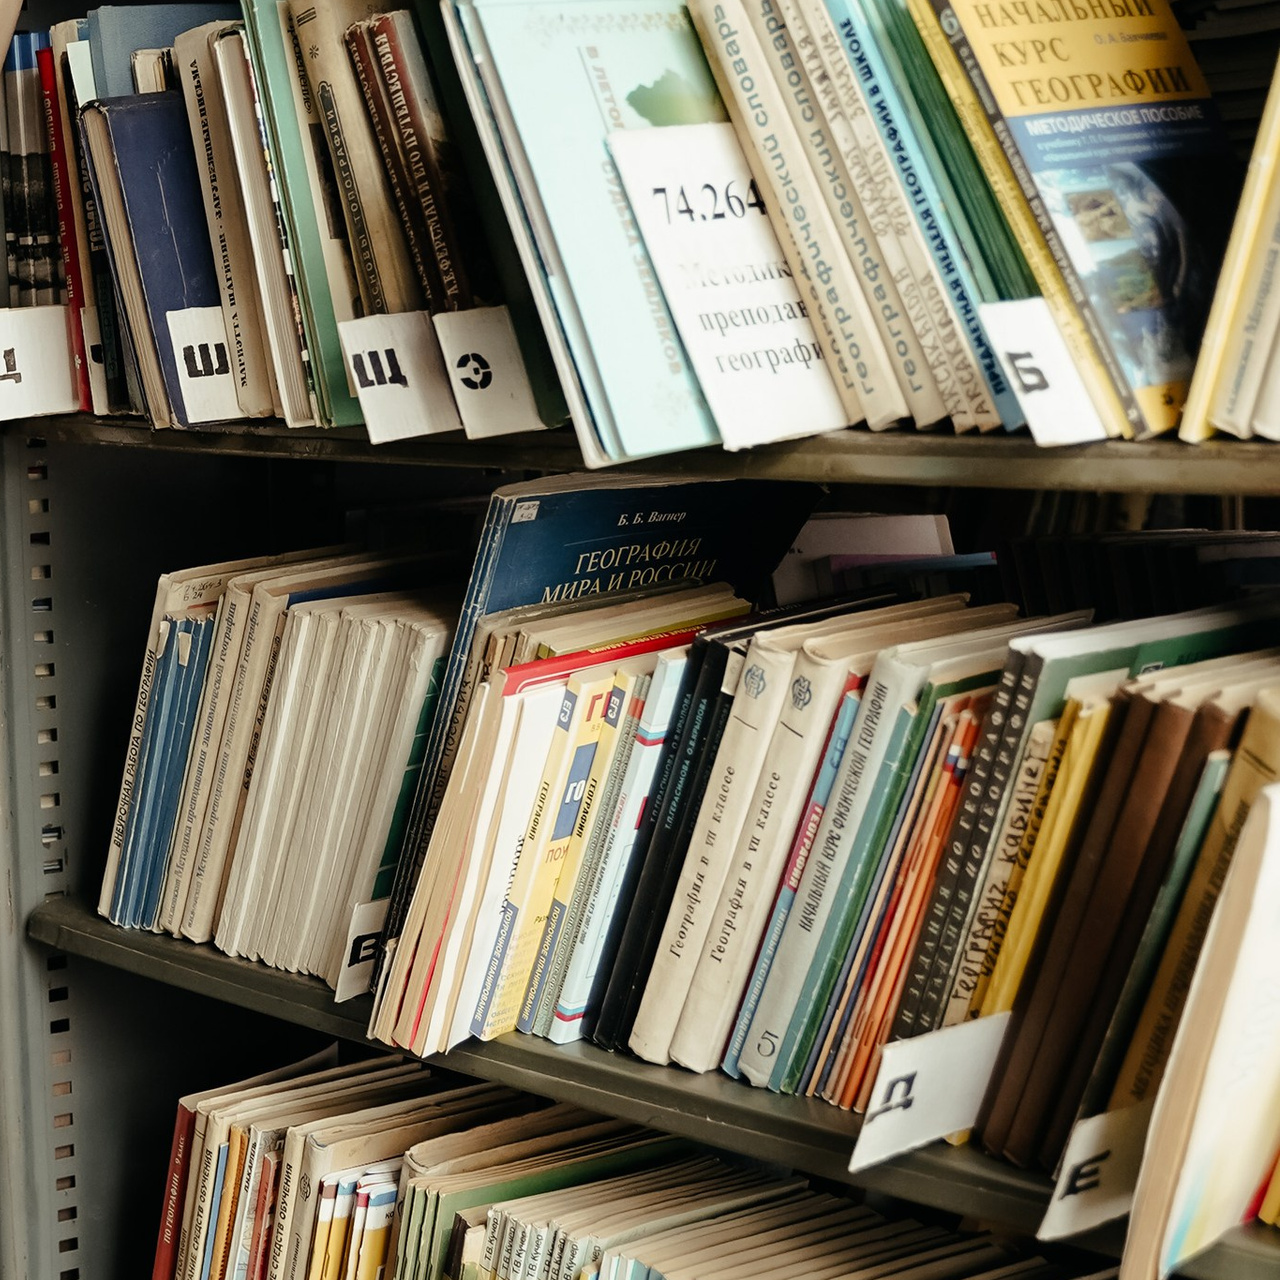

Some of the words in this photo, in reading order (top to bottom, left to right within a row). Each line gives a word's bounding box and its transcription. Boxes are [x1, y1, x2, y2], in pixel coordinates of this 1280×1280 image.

[712, 0, 772, 130] словарь
[990, 37, 1070, 68] КУРС
[188, 57, 208, 119] ПИСЬМА
[1007, 65, 1194, 107] ГЕОГРАФИИ
[198, 118, 222, 220] ЗАРУБЕЖНЫЕ
[325, 107, 361, 224] ТОПОГРАФИИ
[357, 233, 383, 309] ОСНОВЫ
[764, 126, 872, 398] географический
[811, 122, 920, 396] географический
[182, 341, 230, 378] Ш
[226, 311, 248, 387] МАРИЭТТА
[351, 348, 408, 389] Щ
[456, 352, 493, 390] Э
[574, 538, 703, 575] ГЕОГРАФИЯ
[136, 648, 155, 713] ГЕОГРАФИИ
[561, 699, 574, 723] ЕГЭ
[608, 694, 622, 720] ЕГЭ
[132, 713, 145, 732] ПО
[173, 824, 194, 878] Методика
[185, 748, 208, 824] преподавания
[200, 663, 225, 748] экономической
[216, 600, 238, 664] географии
[195, 826, 216, 880] Методика
[207, 749, 231, 826] преподавания
[240, 599, 262, 664] географии
[856, 680, 889, 751] ГЕОГРАФИИ
[125, 735, 140, 777] РАБОТА
[113, 779, 132, 848] ВНЕУРОЧНАЯ
[576, 777, 598, 838] ГЕОГРАФИЯ
[710, 764, 738, 825] классе
[830, 749, 867, 831] ФИЗИЧЕСКОЙ
[696, 854, 713, 867] в
[701, 828, 721, 848] VII
[820, 827, 842, 861] КУРС
[909, 884, 951, 1000] ЗАДАНИЯ
[944, 840, 966, 876] ПО
[960, 668, 1014, 831] ГЕОГРАФИИ
[669, 870, 706, 959] География
[797, 859, 831, 932] НАЧАЛЬНЫЙ
[492, 906, 513, 957] ПОУРОЧНОЕ
[539, 905, 560, 957] ПОУРОЧНОЕ
[475, 956, 497, 1022] ПЛАНИРОВАНИЕ
[522, 956, 545, 1021] ПЛАНИРОВАНИЕ
[867, 1070, 917, 1126] Д
[190, 1204, 204, 1251] СРЕДСТВ
[198, 1148, 213, 1203] ОБУЧЕНИЯ
[1059, 1149, 1110, 1201] Е
[270, 1221, 284, 1270] СРЕДСТВ
[277, 1162, 293, 1220] ОБУЧЕНИЯ
[565, 1242, 578, 1271] Кучер
